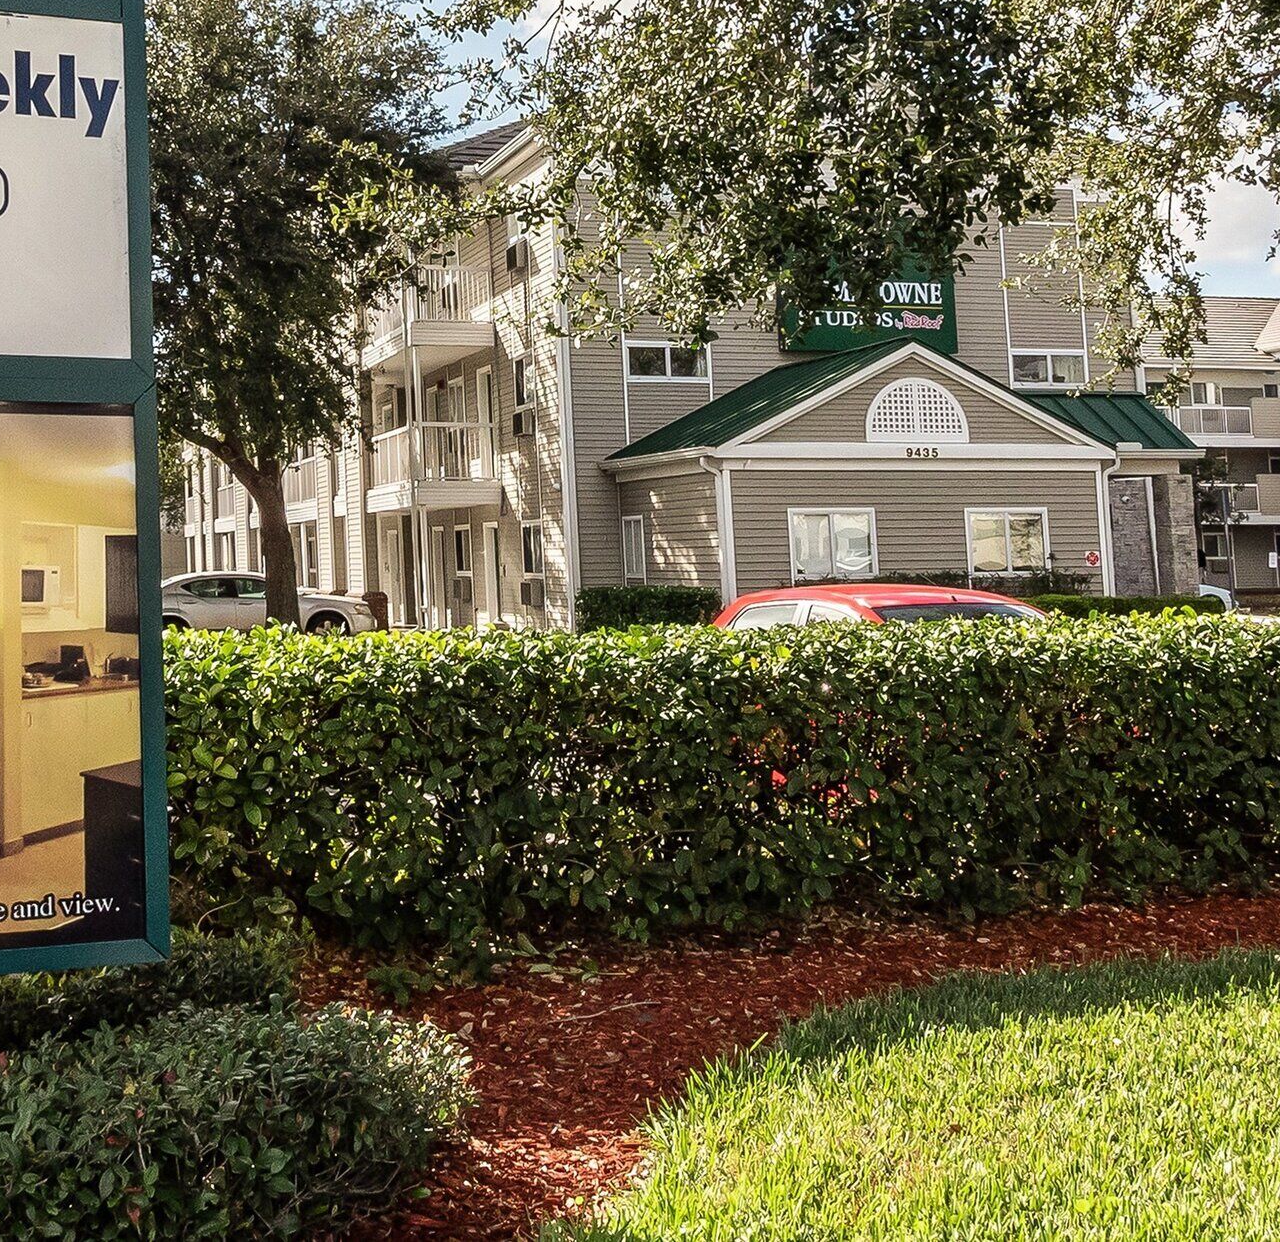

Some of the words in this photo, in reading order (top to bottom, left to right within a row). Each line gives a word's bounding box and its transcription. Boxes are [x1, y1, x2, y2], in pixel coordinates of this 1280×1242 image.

[906, 447, 939, 458] 9435
[13, 896, 53, 919] and
[62, 895, 121, 916] view.
